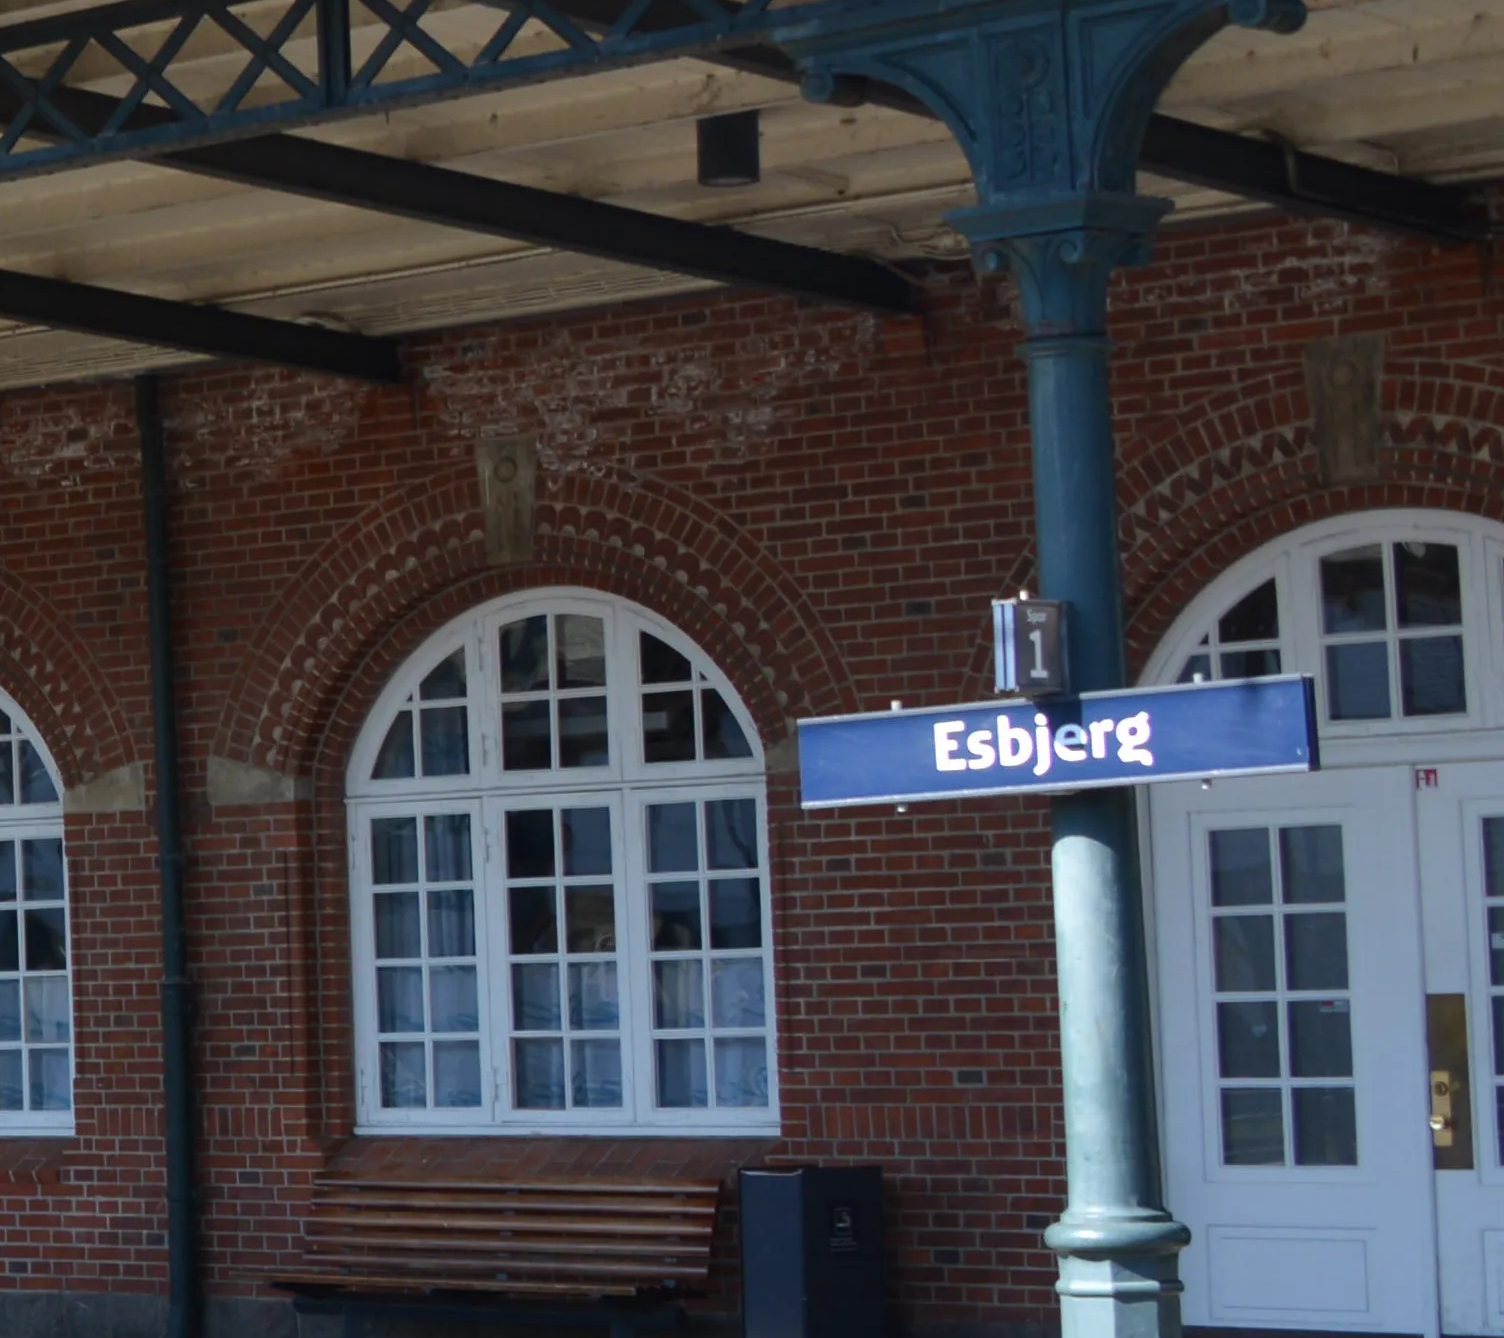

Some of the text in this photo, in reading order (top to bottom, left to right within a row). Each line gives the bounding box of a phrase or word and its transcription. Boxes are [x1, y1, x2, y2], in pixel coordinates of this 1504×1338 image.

[1026, 610, 1048, 626] Spor
[1029, 629, 1048, 679] 1
[933, 711, 1154, 776] Esbjerg
